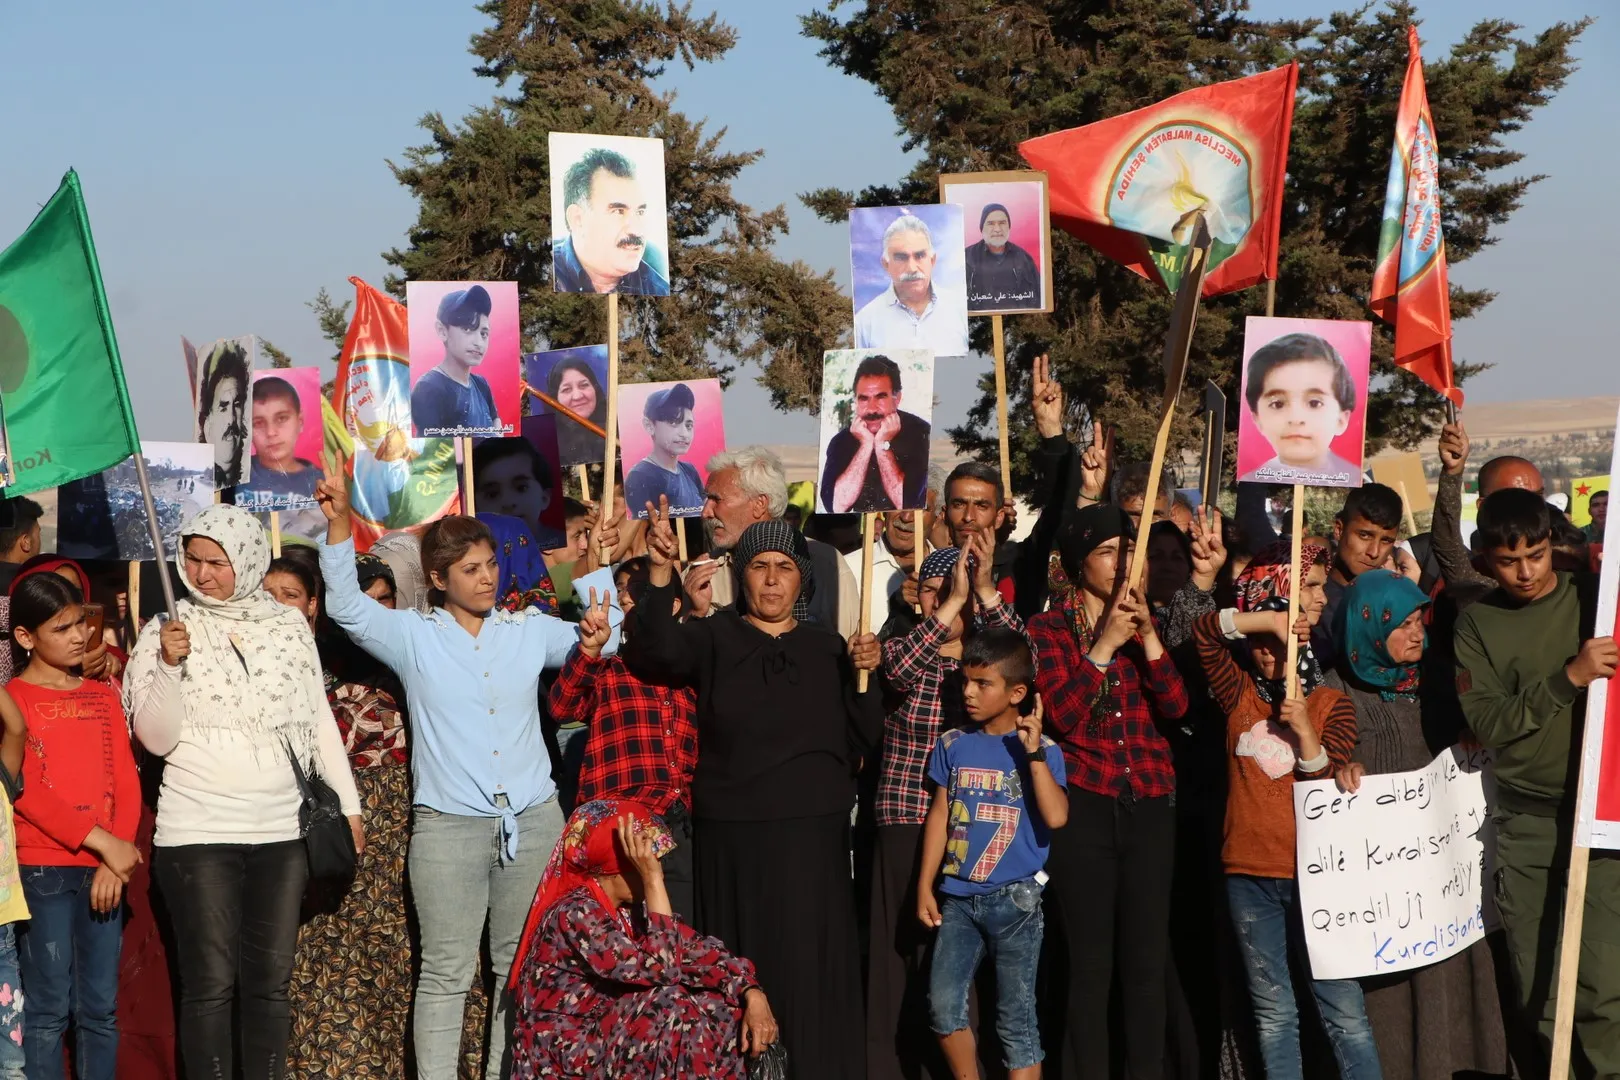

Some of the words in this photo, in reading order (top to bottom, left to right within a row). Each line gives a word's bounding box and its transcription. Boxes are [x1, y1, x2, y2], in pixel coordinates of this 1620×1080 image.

[970, 292, 993, 303] شعبان
[994, 291, 1007, 304] علي
[1303, 789, 1358, 820] Ger
[968, 802, 1021, 882] 7
[1307, 844, 1346, 874] dilê
[1311, 892, 1391, 932] Qendil
